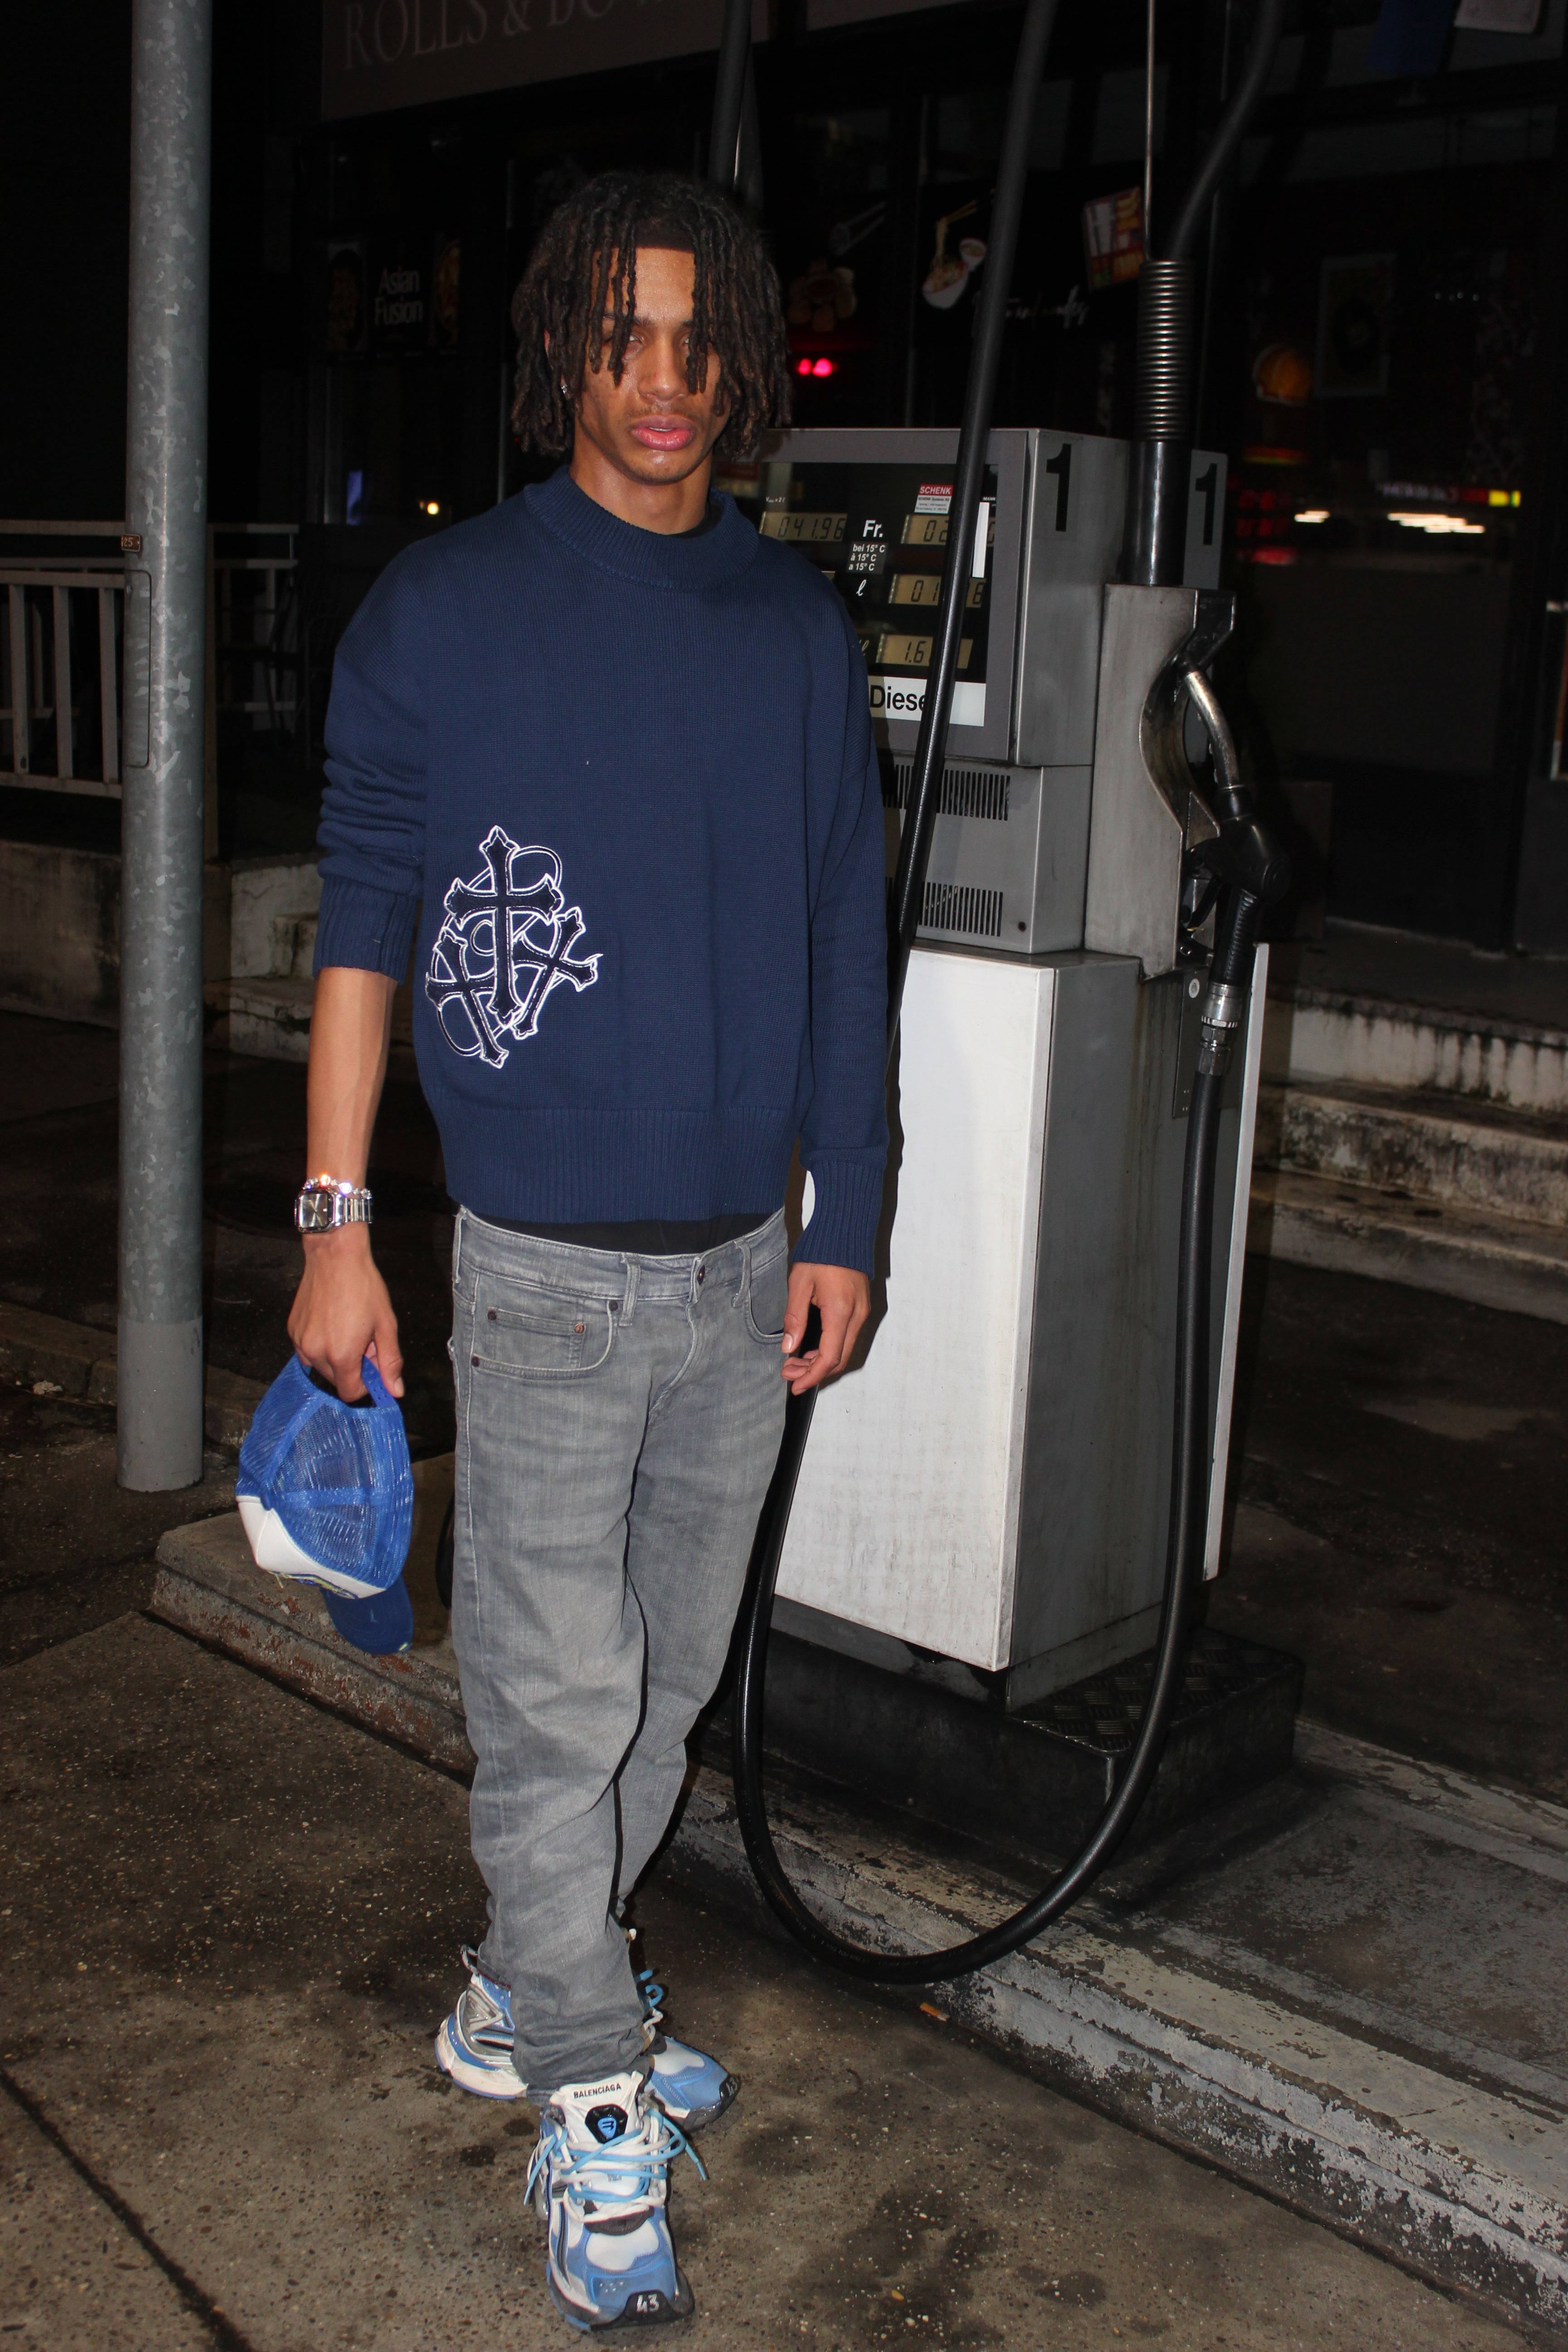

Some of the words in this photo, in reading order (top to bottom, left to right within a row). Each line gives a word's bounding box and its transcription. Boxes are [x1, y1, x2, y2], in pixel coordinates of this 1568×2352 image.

[343, 0, 488, 71] ROLLS
[377, 265, 421, 295] Asian
[373, 296, 424, 327] Fusion
[919, 486, 951, 495] SCHENK
[1046, 443, 1072, 532] 1
[1195, 463, 1217, 546] 1
[862, 519, 883, 538] Fr.
[850, 553, 856, 561] à
[858, 553, 869, 562] 15°
[870, 554, 877, 562] C
[853, 544, 864, 552] bei
[866, 544, 878, 553] 15°
[855, 562, 867, 571] 15°
[869, 685, 926, 711] Diese
[573, 2082, 622, 2099] BALENCIAGA
[636, 2293, 660, 2313] 43
